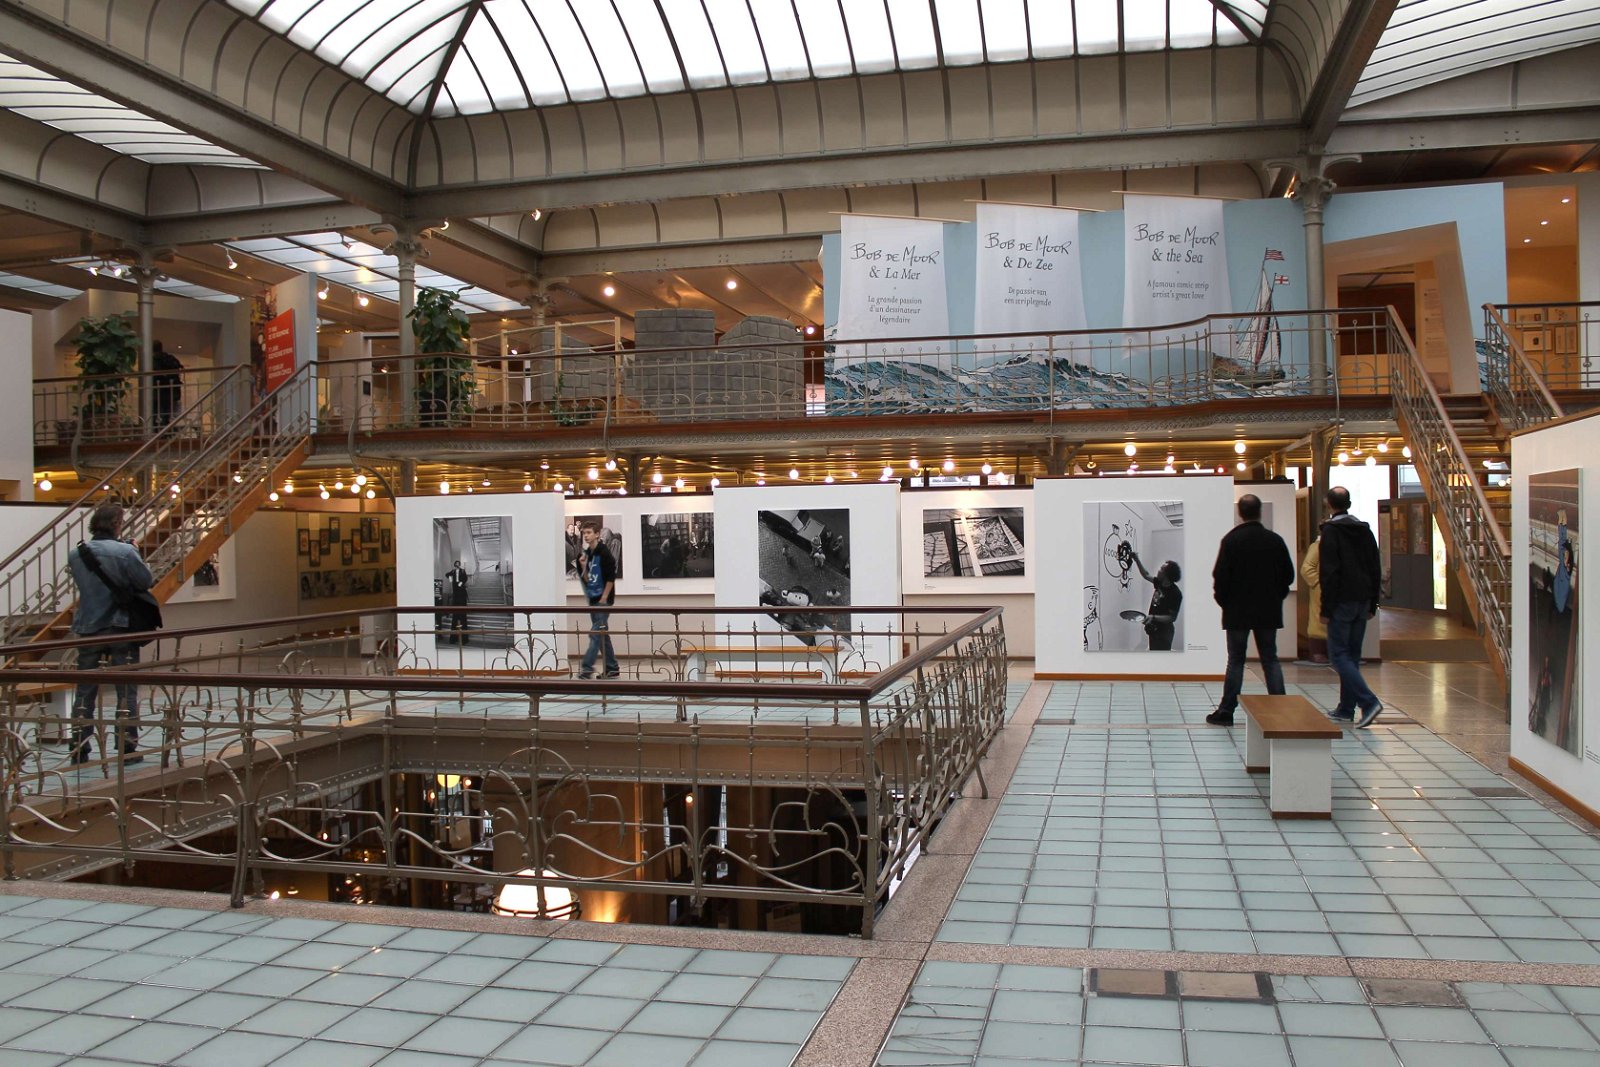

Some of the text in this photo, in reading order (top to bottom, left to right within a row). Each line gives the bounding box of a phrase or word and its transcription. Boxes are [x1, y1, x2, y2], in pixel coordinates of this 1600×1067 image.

[1151, 248, 1204, 264] & the Sea
[1003, 256, 1053, 271] & De Zee
[869, 265, 921, 280] & La Mer
[1008, 286, 1015, 294] De
[1016, 287, 1036, 296] passie
[1147, 280, 1209, 291] A famous comic strip
[868, 295, 922, 305] La grande passion
[1152, 290, 1204, 301] artist's great love
[869, 305, 921, 314] d'un dessinateur
[879, 314, 911, 325] légendaire
